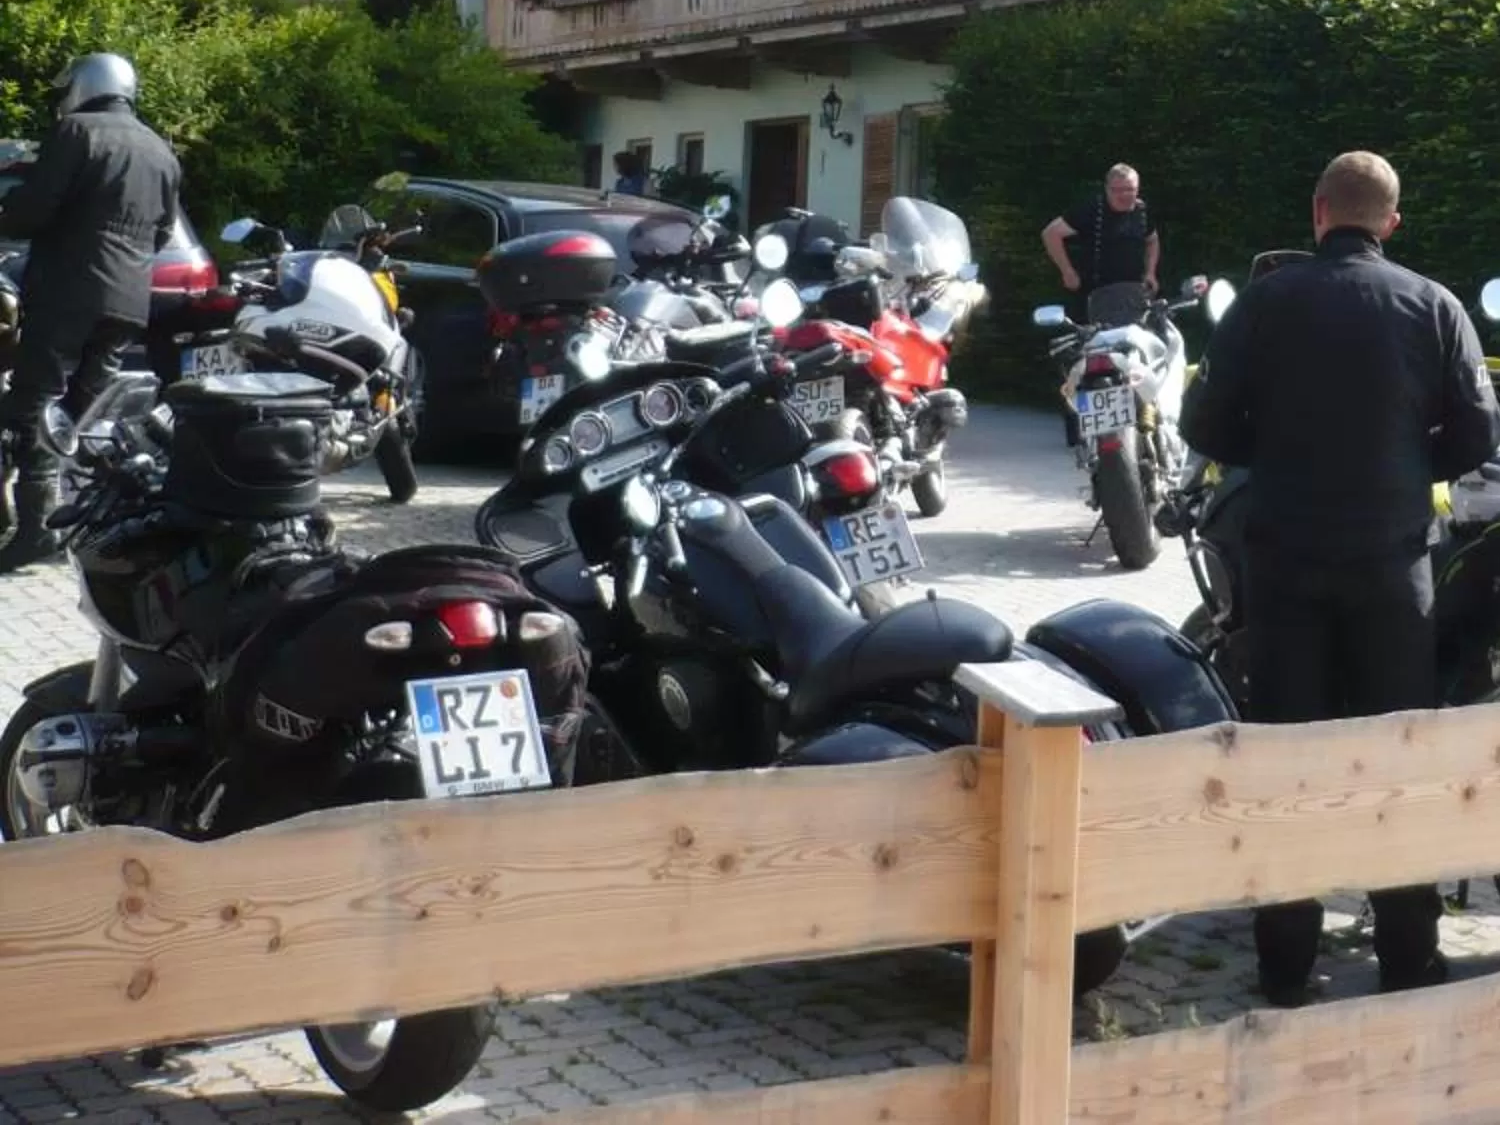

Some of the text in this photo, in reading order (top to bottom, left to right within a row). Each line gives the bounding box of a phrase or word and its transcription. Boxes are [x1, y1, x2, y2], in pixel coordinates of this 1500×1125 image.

[195, 347, 222, 369] KA
[817, 398, 841, 417] 95
[1093, 390, 1117, 410] OF
[1082, 408, 1132, 432] FF 11
[843, 511, 887, 547] RE
[843, 541, 911, 580] T 51
[421, 714, 433, 728] D
[437, 685, 499, 733] RZ
[430, 730, 526, 784] LI 7
